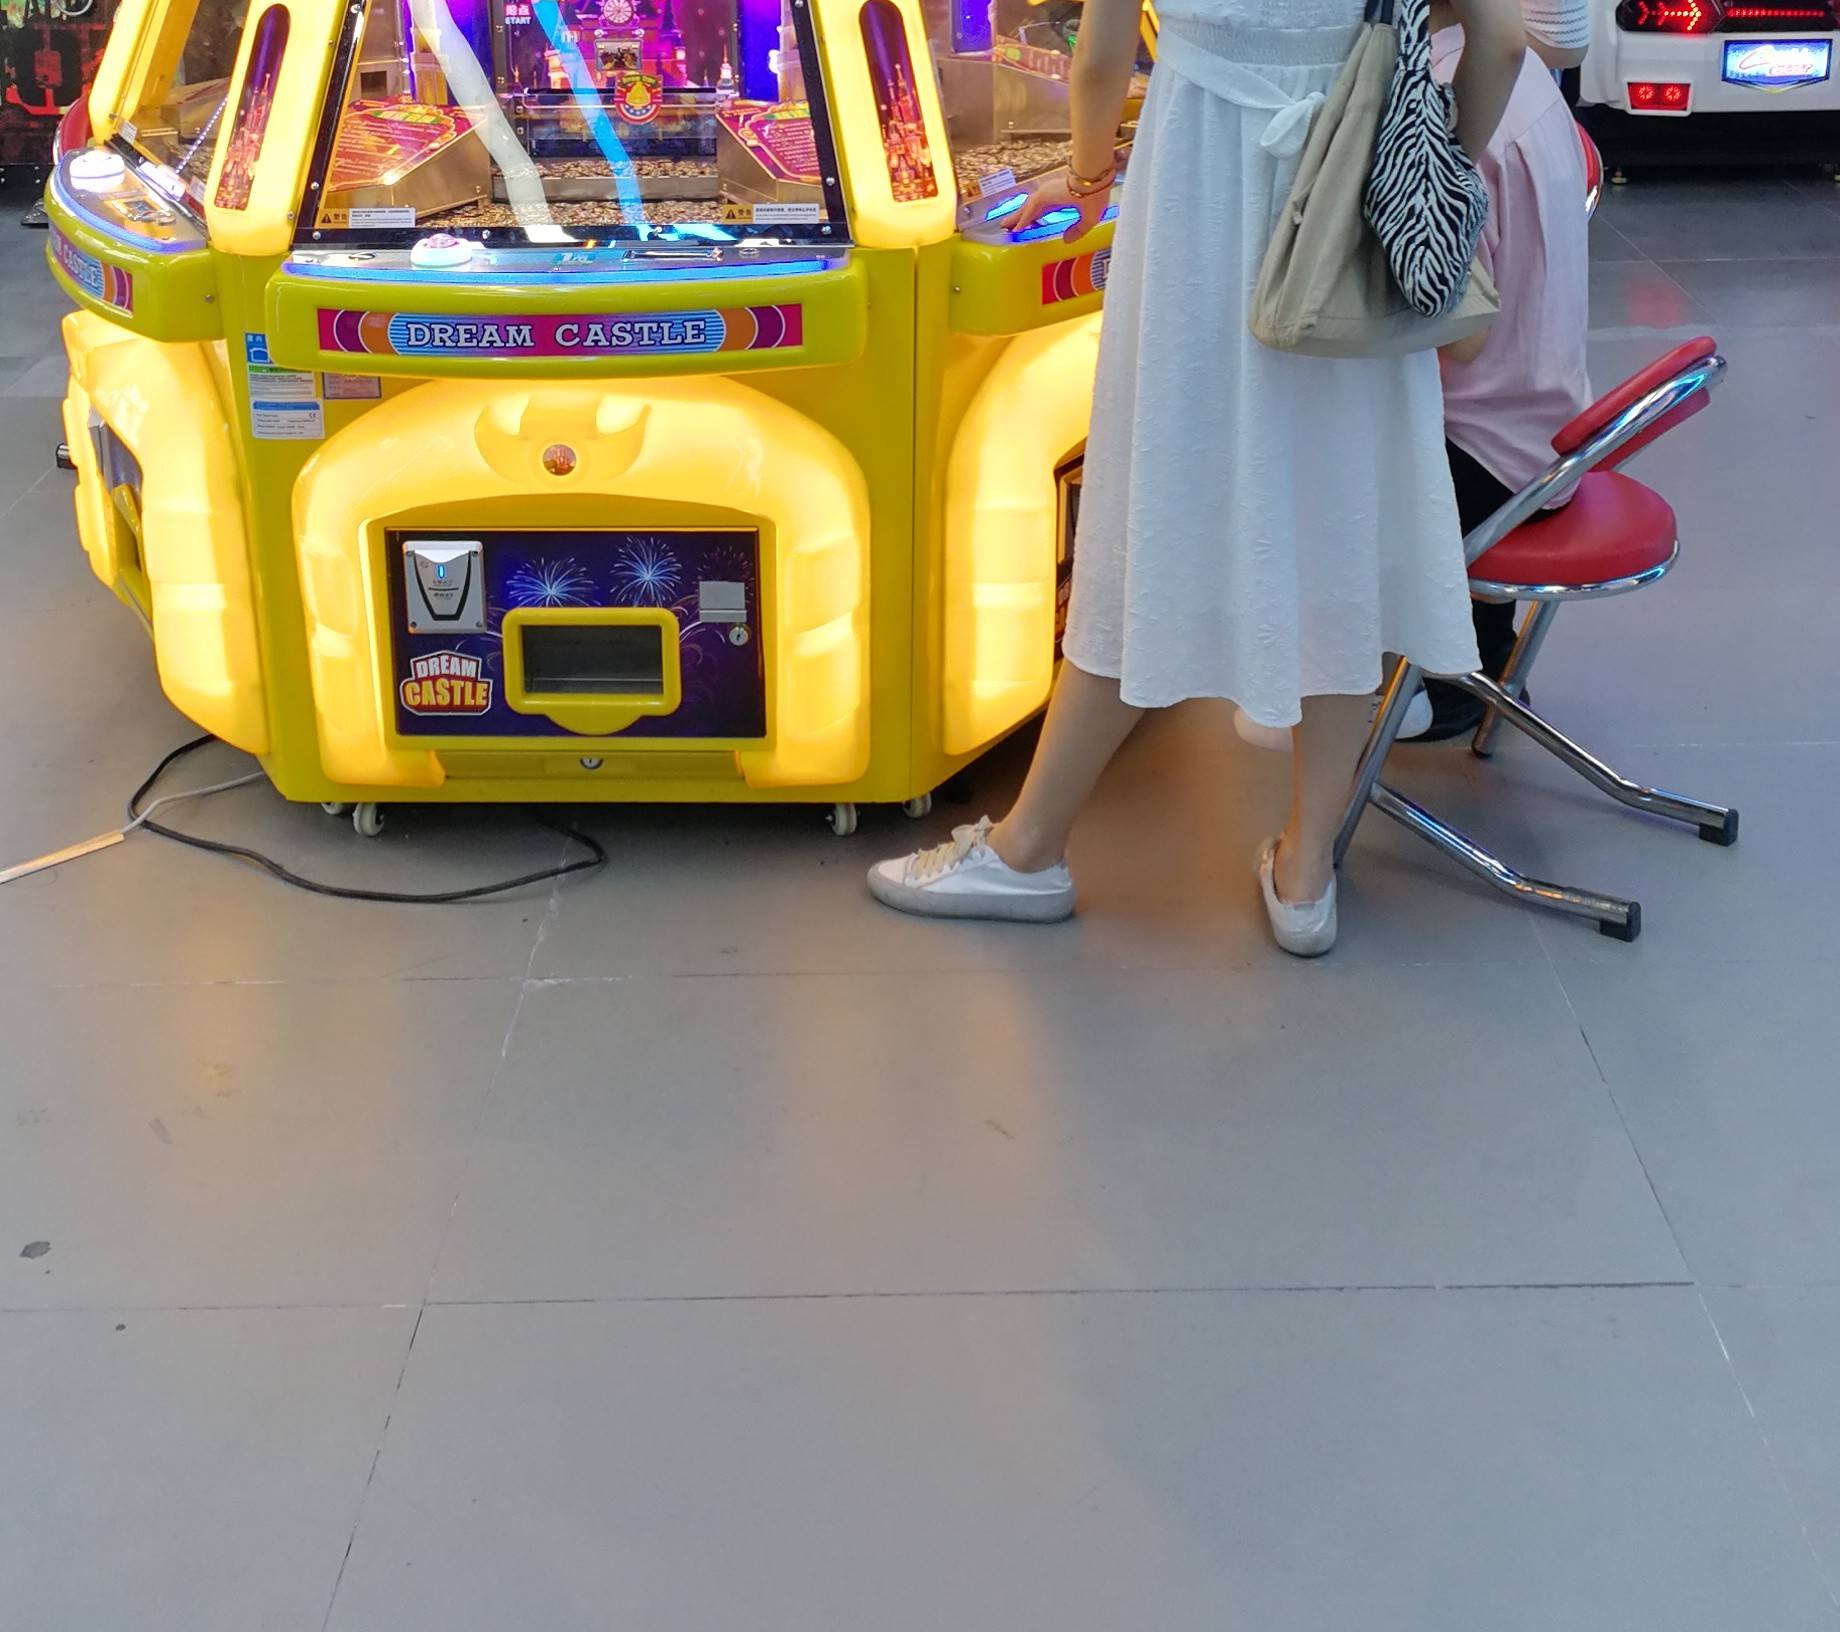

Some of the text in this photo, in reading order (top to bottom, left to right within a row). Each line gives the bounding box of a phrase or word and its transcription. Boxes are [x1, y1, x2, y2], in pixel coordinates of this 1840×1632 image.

[505, 17, 532, 25] START
[407, 320, 706, 347] DREAM CASTLE
[416, 654, 477, 678] DREAM
[405, 678, 489, 705] CASTLE
